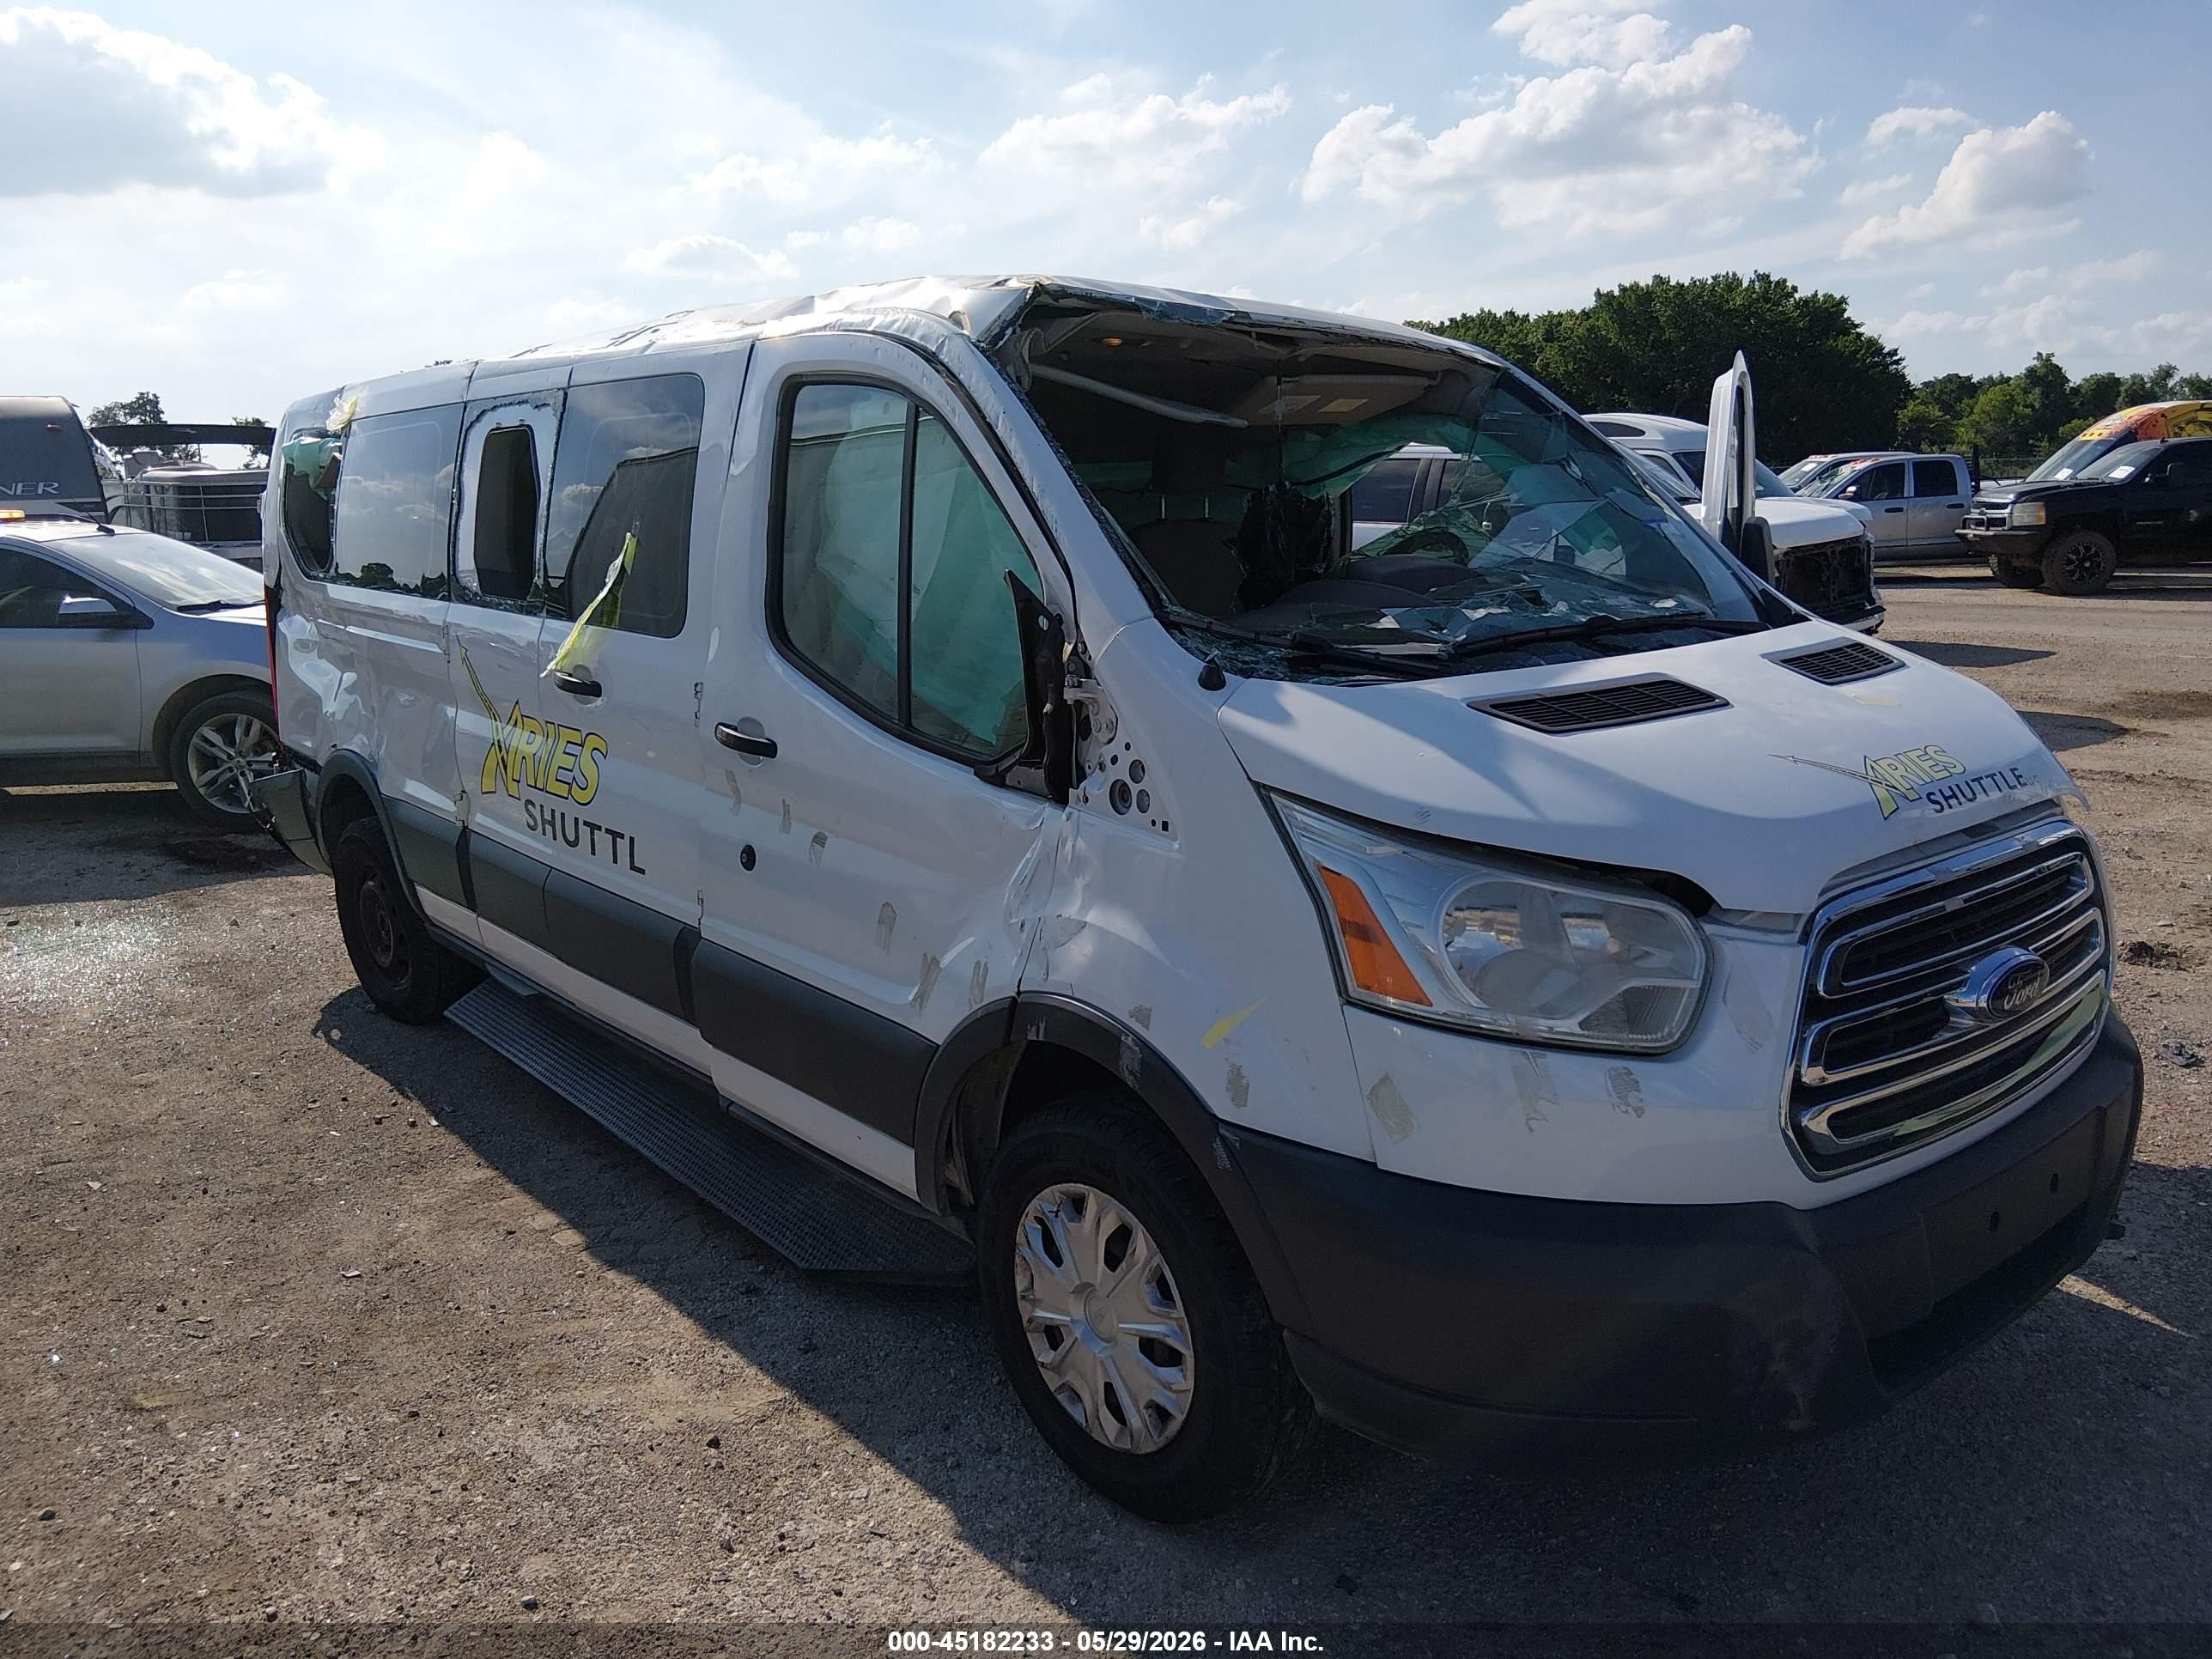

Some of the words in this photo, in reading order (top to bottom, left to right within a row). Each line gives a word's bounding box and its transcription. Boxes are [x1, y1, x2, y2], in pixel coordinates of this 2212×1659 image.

[481, 700, 608, 805] ARIES
[1864, 744, 1966, 820] ARIES
[1924, 767, 2028, 814] SHUTTLE
[524, 798, 646, 876] SHUTTL
